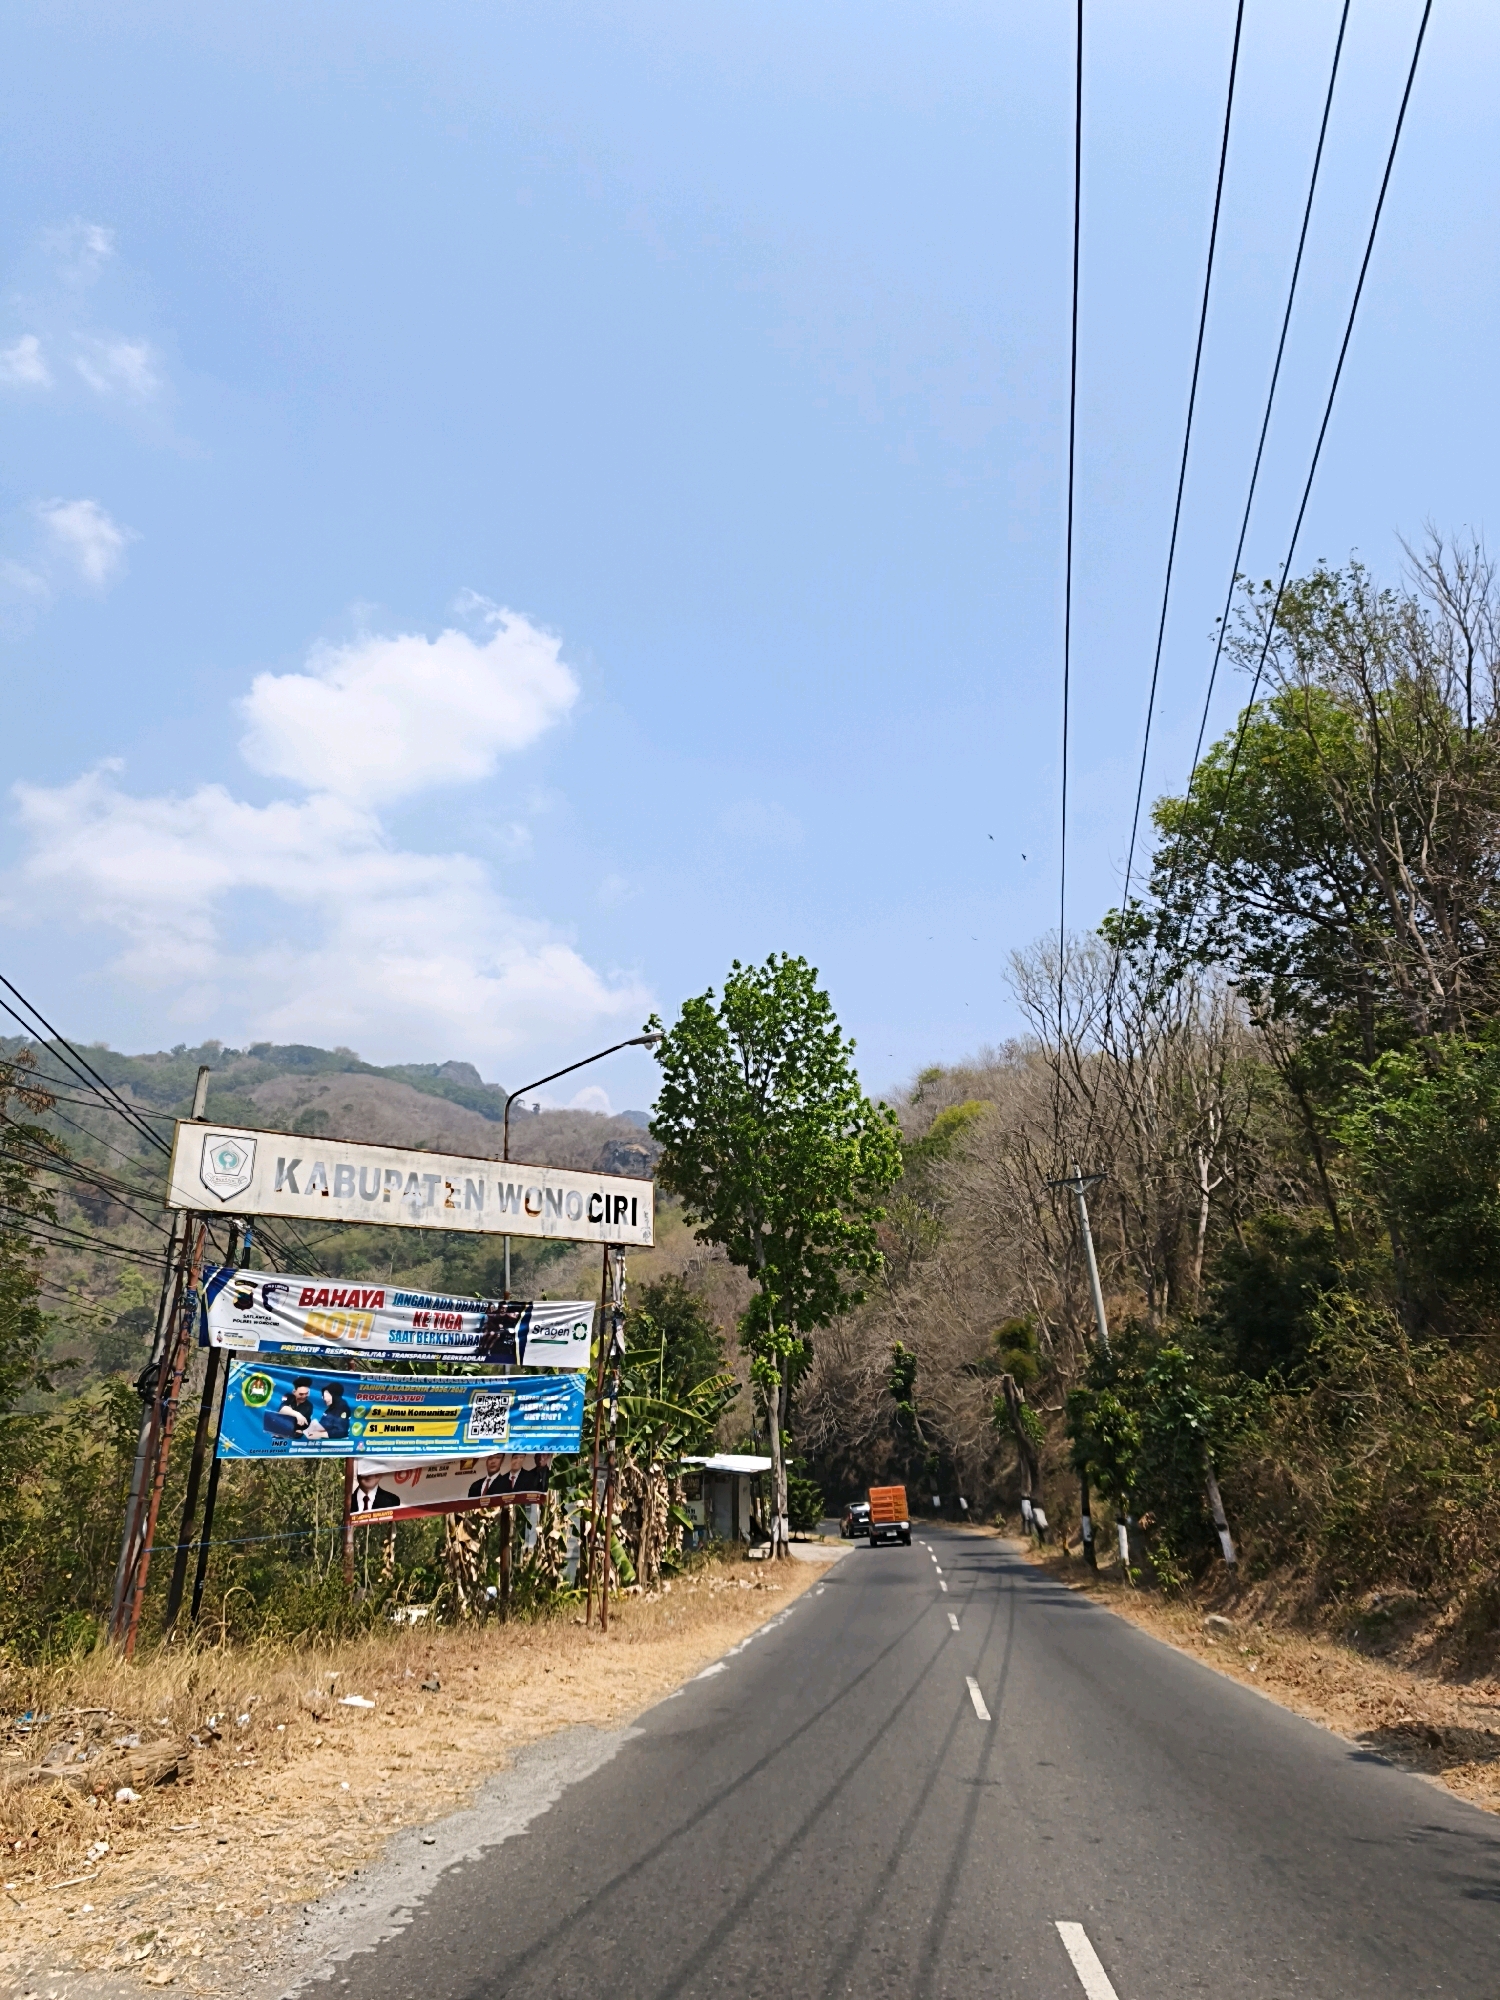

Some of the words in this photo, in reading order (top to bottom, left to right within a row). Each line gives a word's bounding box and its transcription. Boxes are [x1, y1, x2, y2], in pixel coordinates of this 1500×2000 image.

[274, 1157, 485, 1211] KABUPATEN
[298, 1287, 386, 1309] BAHAYA
[393, 1292, 432, 1309] JANGAN
[432, 1296, 454, 1310] ADA
[455, 1300, 488, 1313] ORANG
[303, 1311, 376, 1340] BOTI
[412, 1311, 429, 1328] KE
[432, 1312, 464, 1330] TIGA
[388, 1329, 415, 1343] SAAT
[416, 1331, 481, 1347] BERKENDARA
[531, 1324, 570, 1340] Sragen
[280, 1344, 320, 1353] PREDIKTIF
[391, 1352, 441, 1360] TRANSPARANSI
[355, 1393, 400, 1402] PROGRAM
[400, 1394, 426, 1402] STUDI
[407, 1408, 458, 1417] Komunikasi
